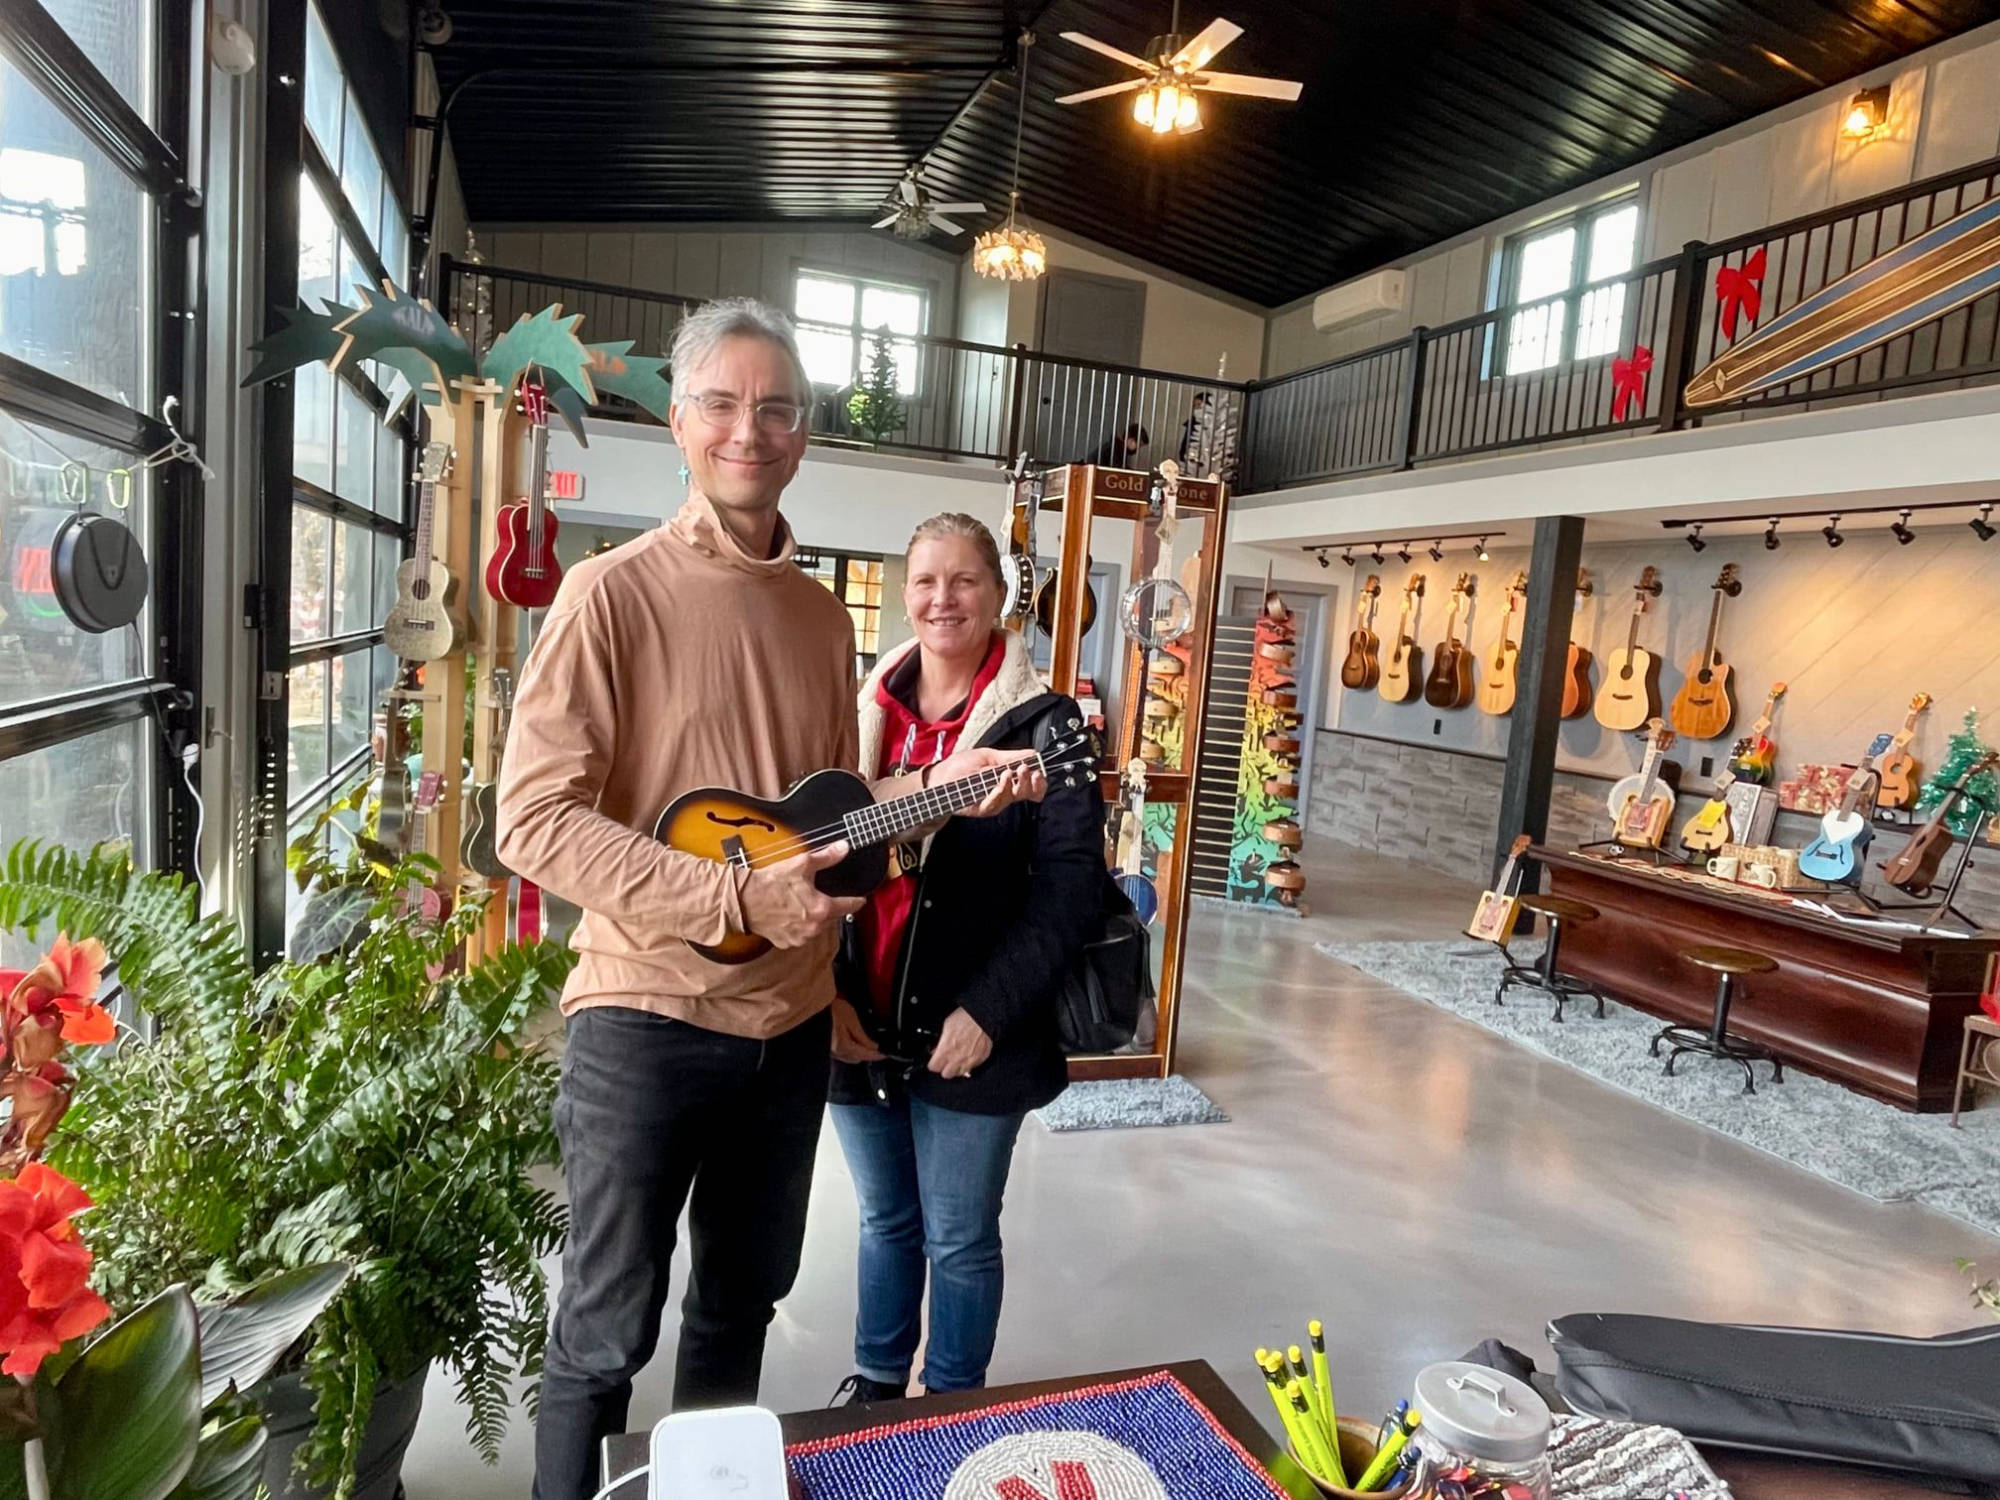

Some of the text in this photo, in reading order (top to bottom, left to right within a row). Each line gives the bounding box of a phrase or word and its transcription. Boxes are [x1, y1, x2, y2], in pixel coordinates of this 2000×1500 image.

[555, 471, 577, 497] XIT
[1105, 474, 1208, 500] Gold one
